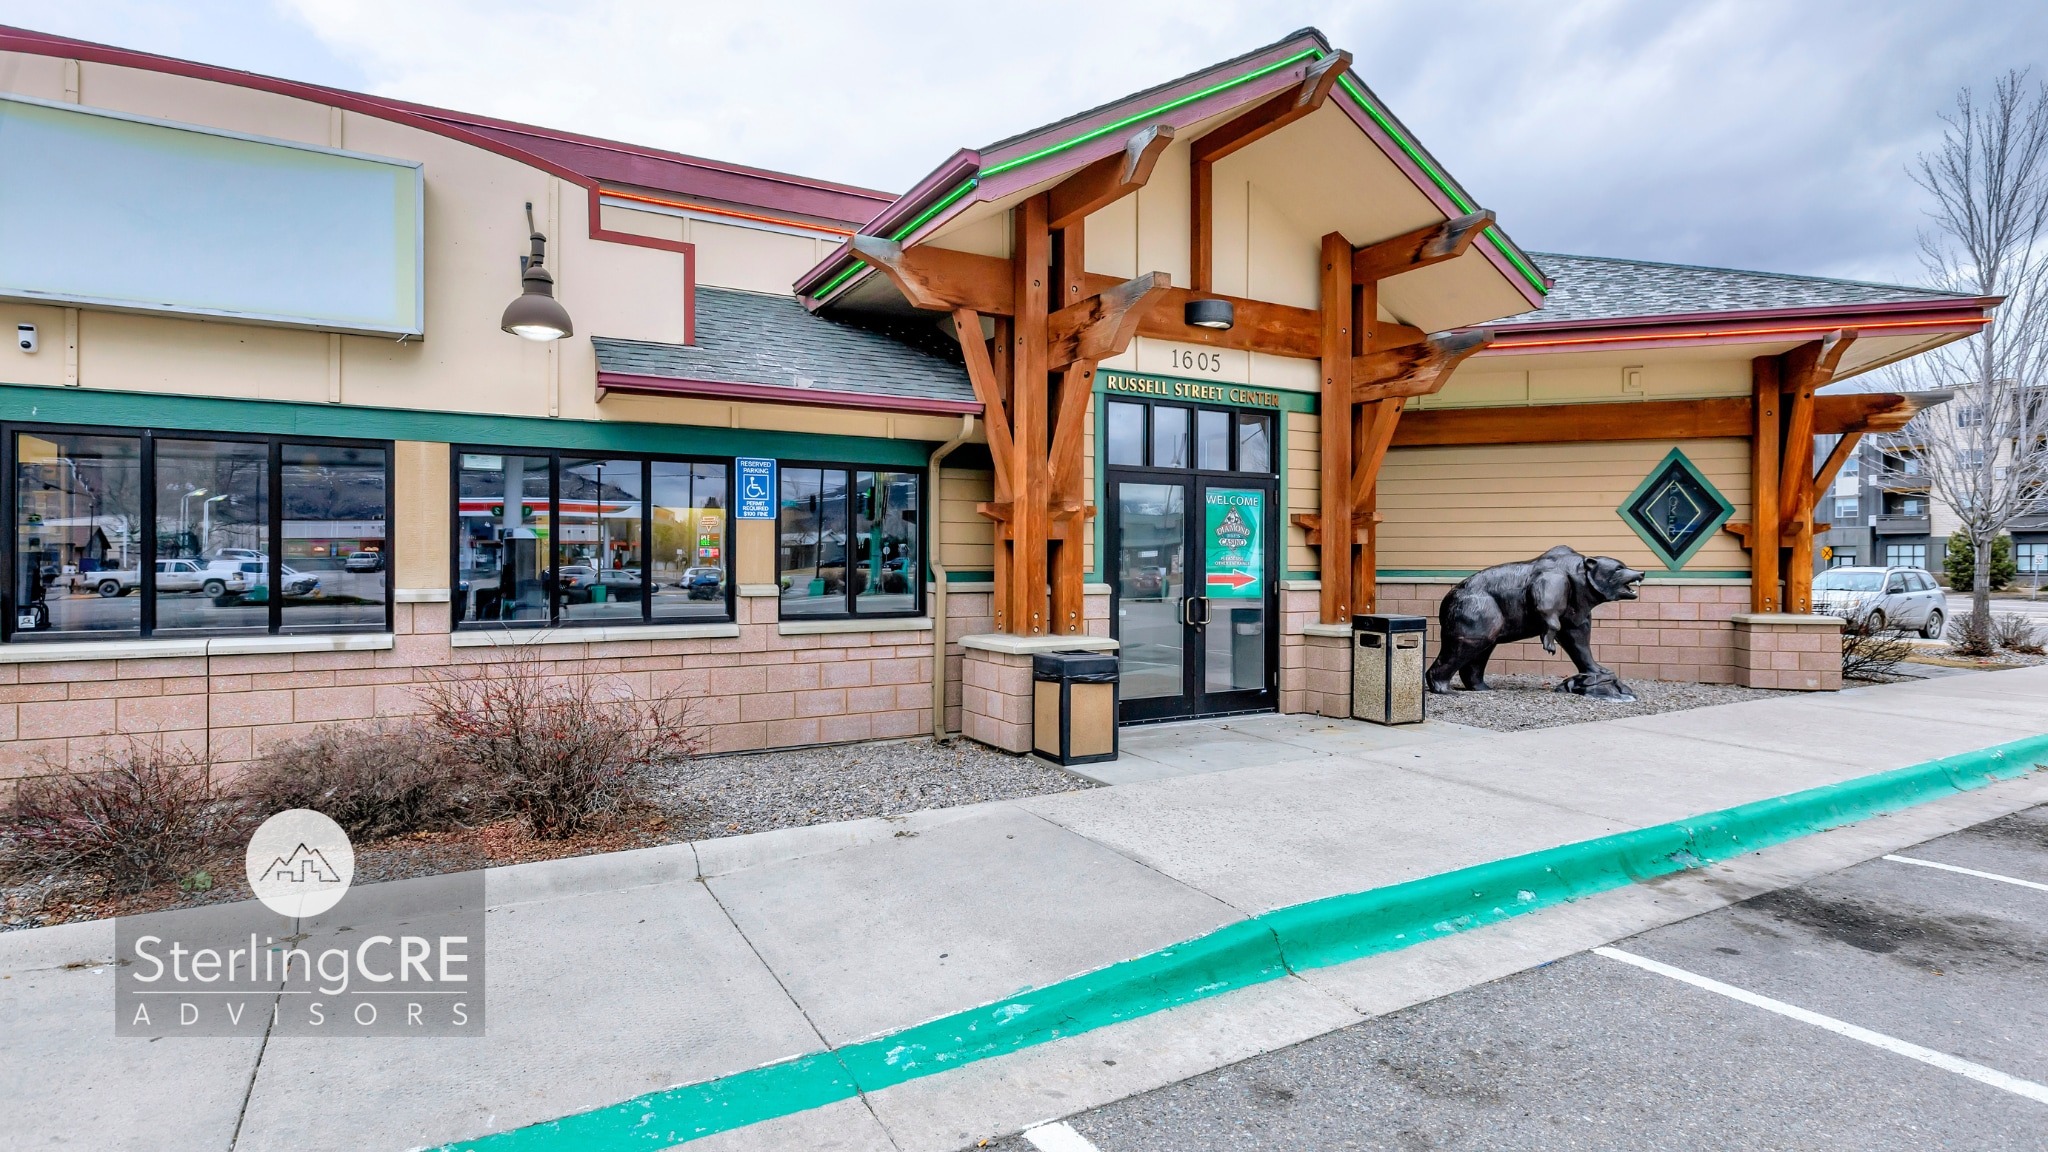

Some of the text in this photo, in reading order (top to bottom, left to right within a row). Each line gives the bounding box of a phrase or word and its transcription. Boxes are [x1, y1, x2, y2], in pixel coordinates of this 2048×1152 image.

[1172, 349, 1221, 373] 1605
[1107, 375, 1280, 407] RUSSELL STREET CENTER
[1206, 495, 1259, 506] WELCOME
[1216, 524, 1250, 536] DIAMOND
[1220, 538, 1246, 546] CASINO
